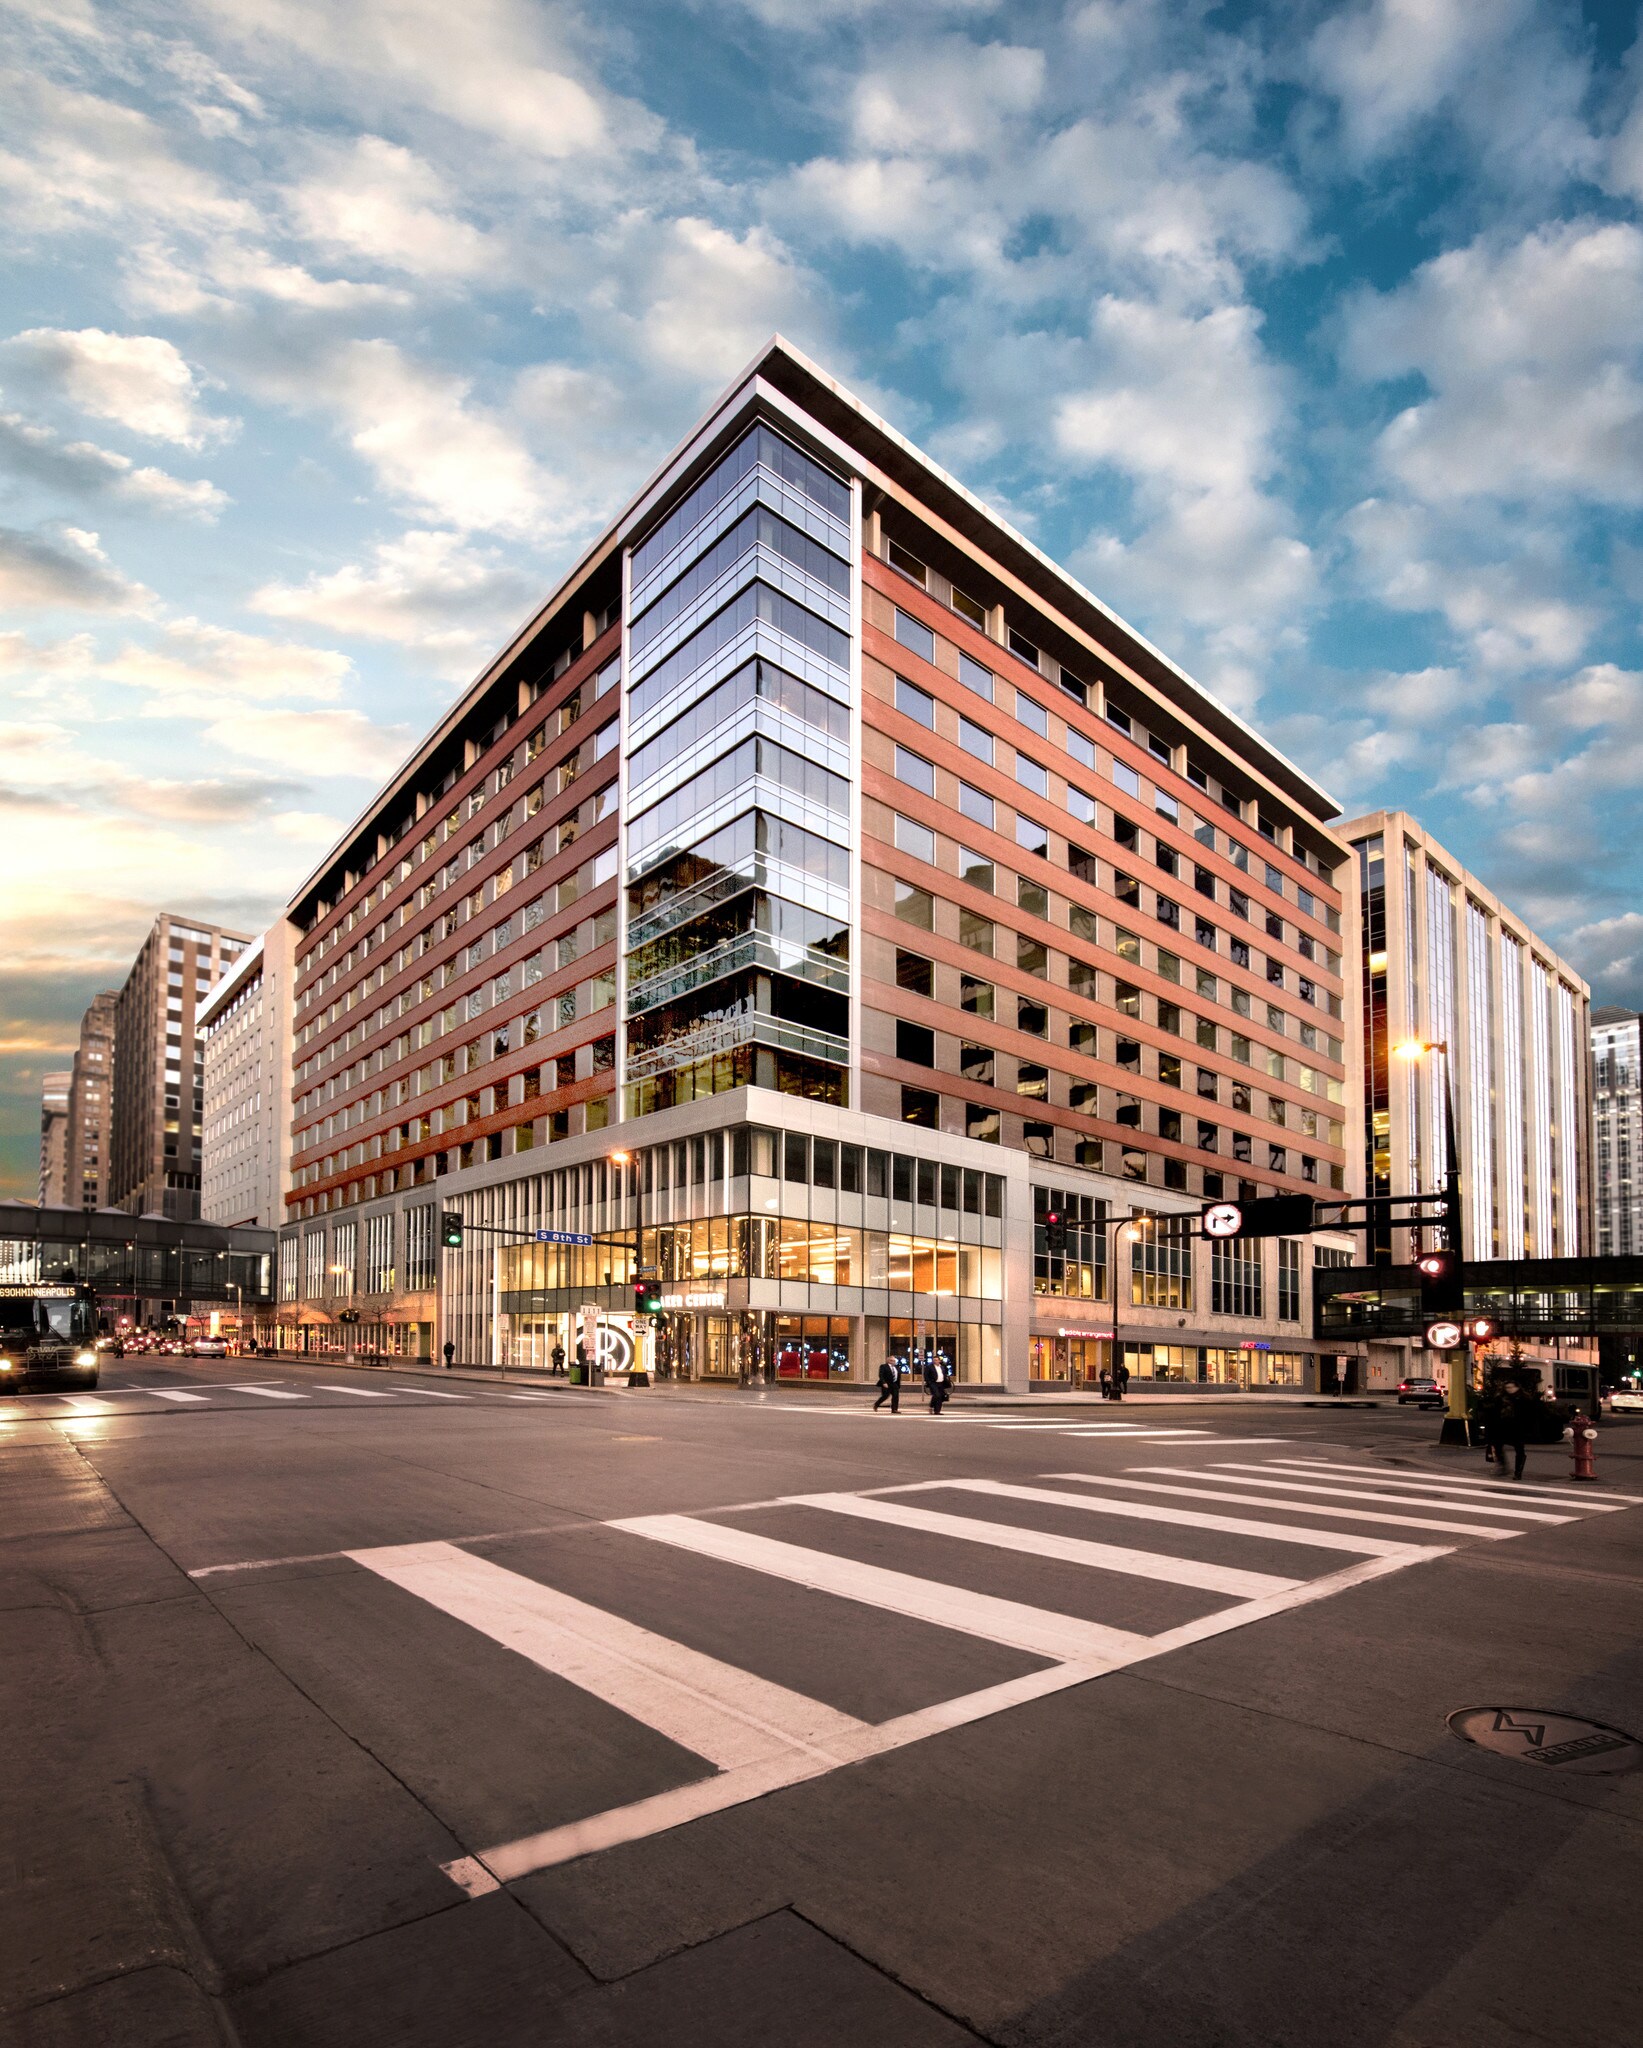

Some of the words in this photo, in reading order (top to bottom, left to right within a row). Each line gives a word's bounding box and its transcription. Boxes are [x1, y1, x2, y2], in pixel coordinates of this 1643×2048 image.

[540, 1231, 548, 1240] S
[552, 1233, 572, 1242] 8th
[576, 1235, 589, 1244] St
[660, 1295, 684, 1308] AKER
[1526, 1736, 1614, 1760] STERLING
